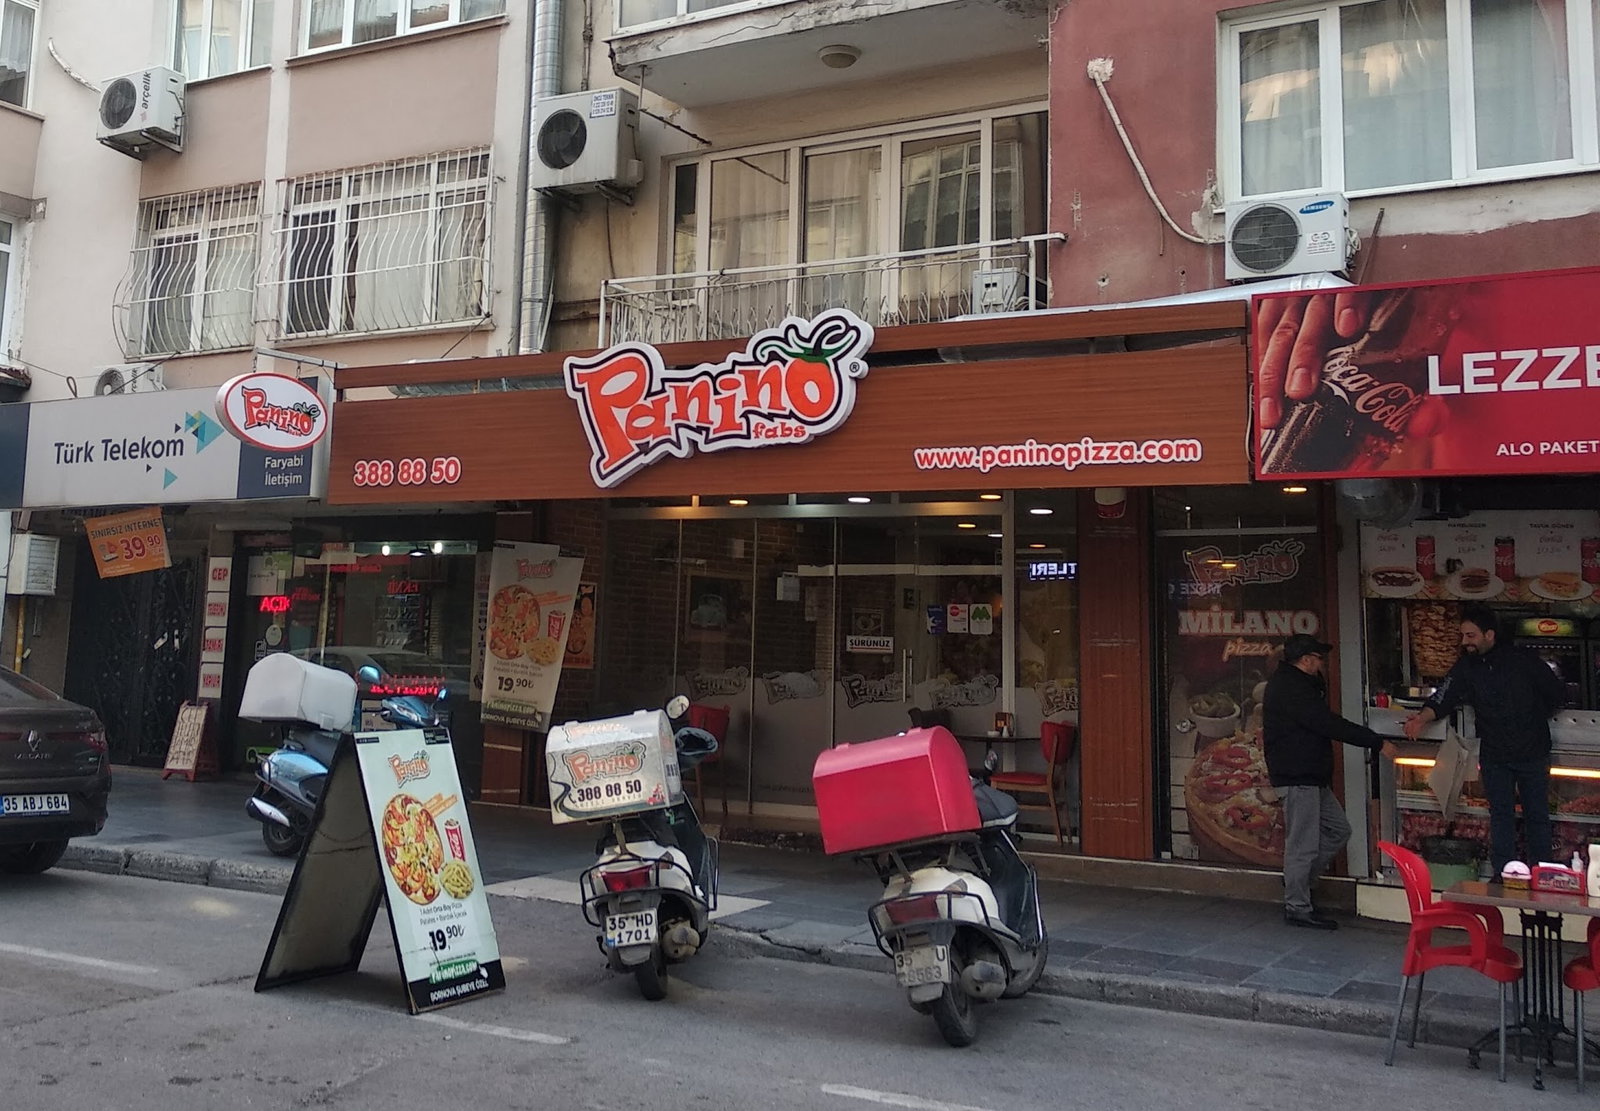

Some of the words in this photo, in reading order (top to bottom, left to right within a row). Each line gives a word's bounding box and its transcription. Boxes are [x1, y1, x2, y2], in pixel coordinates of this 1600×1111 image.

[141, 72, 152, 109] arçelik
[241, 386, 319, 436] Panino
[570, 328, 850, 478] Panino
[752, 421, 807, 439] fabs
[54, 440, 95, 464] Türk
[101, 436, 184, 461] Telekom
[914, 437, 1202, 472] www.paninopizza.com
[1497, 444, 1534, 456] ALO
[1540, 441, 1600, 455] PAKET
[265, 455, 304, 470] Faryabi
[353, 460, 394, 486] 388
[397, 458, 427, 485] 88
[430, 456, 461, 484] 50
[265, 471, 303, 487] İletişim
[120, 536, 146, 560] 39
[1178, 604, 1320, 635] MİLANO
[1223, 637, 1273, 662] pizza
[388, 752, 431, 786] Panino
[564, 745, 642, 786] Panino
[577, 785, 602, 802] 388
[605, 783, 622, 797] 88
[625, 779, 642, 794] 50
[4, 797, 18, 811] 35
[23, 796, 43, 810] ABJ
[47, 795, 68, 809] 684
[609, 916, 626, 931] 35
[635, 913, 653, 927] HD
[617, 929, 651, 944] 1701
[896, 952, 913, 968] 35
[936, 947, 946, 962] U
